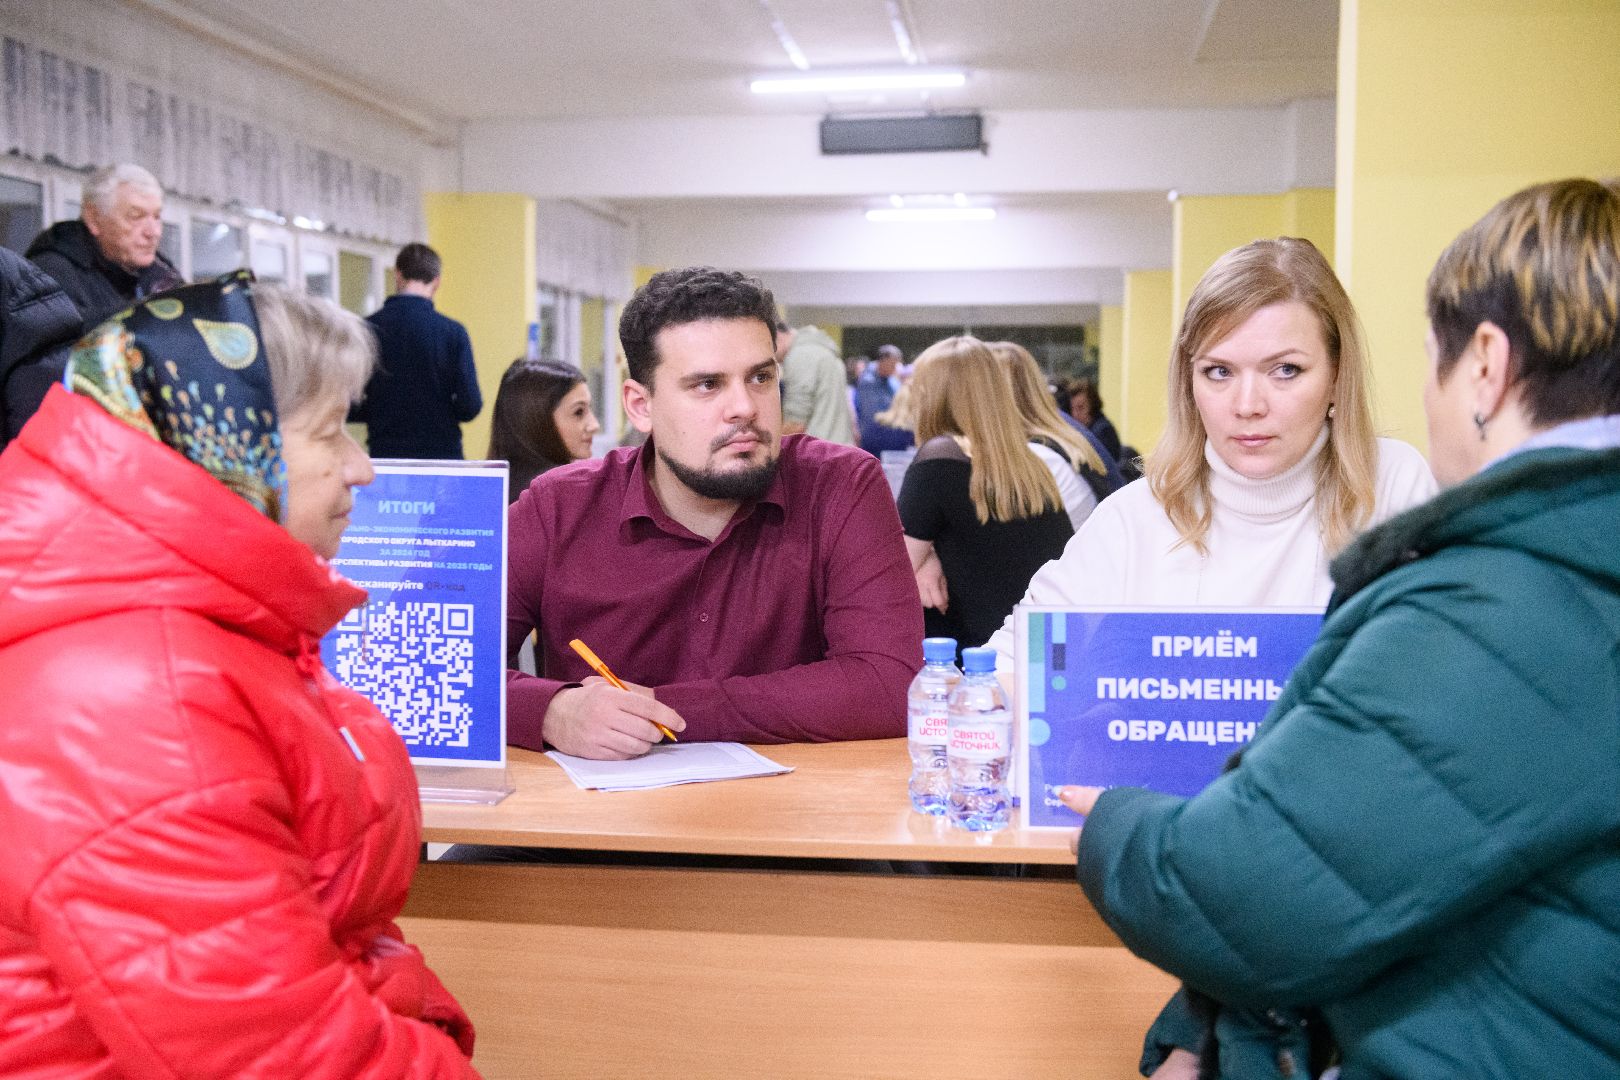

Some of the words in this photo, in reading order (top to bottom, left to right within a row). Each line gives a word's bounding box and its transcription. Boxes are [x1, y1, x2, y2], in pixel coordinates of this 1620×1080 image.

[378, 500, 436, 514] ИТОГИ
[449, 528, 494, 536] РАЗВИТИЯ
[341, 536, 390, 545] ОРОДСКОГО
[390, 537, 423, 546] ОКРУГА
[423, 538, 476, 547] ЛЫТКАРИНО
[380, 548, 391, 556] ЗА
[413, 549, 430, 558] ГОД
[330, 558, 388, 567] ЕРСПЕКТИВЫ
[389, 559, 433, 568] РАЗВИТИЯ
[433, 561, 446, 569] НА
[468, 563, 493, 571] ГОДЫ
[351, 580, 424, 592] тсканируйте
[1152, 630, 1257, 657] ПРИЁМ
[925, 718, 948, 727] СВЯ
[919, 727, 947, 736] ИСТО
[1108, 720, 1260, 746] ОБРАЩЕН
